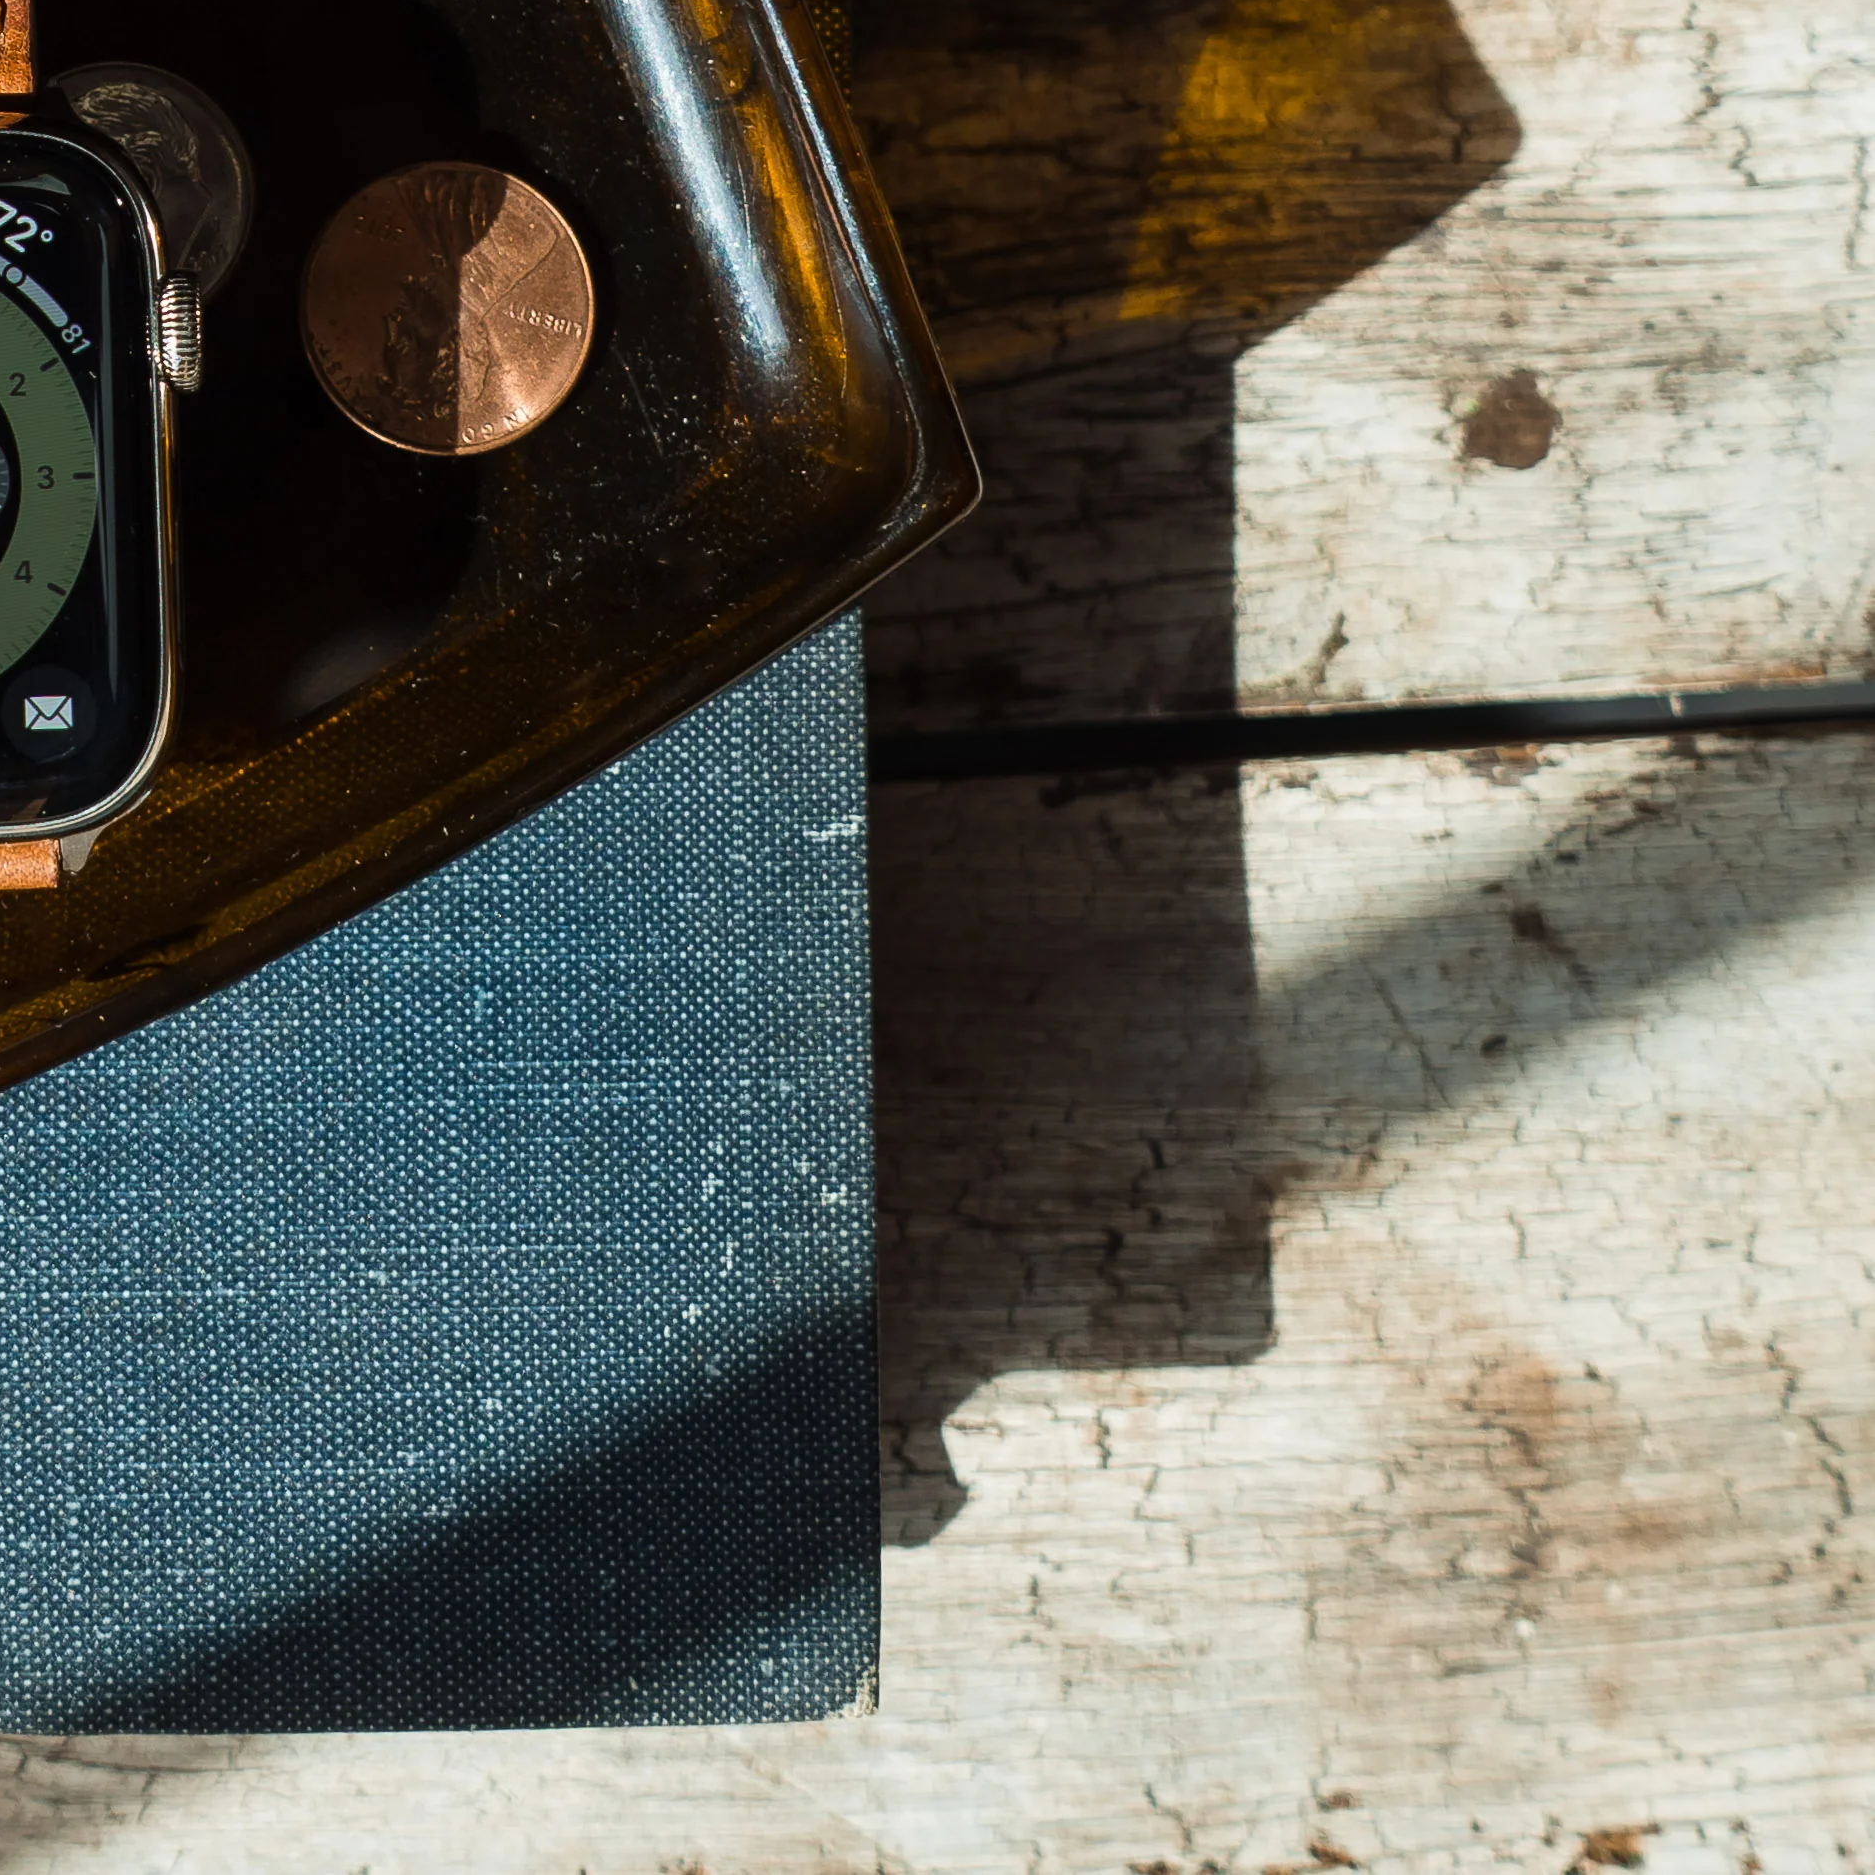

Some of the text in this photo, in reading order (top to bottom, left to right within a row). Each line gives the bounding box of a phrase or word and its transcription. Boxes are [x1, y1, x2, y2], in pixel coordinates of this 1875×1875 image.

[507, 301, 583, 339] LIBERTY
[61, 324, 92, 355] 81
[9, 373, 27, 397] 2
[37, 465, 56, 490] 3
[13, 560, 34, 584] 4
